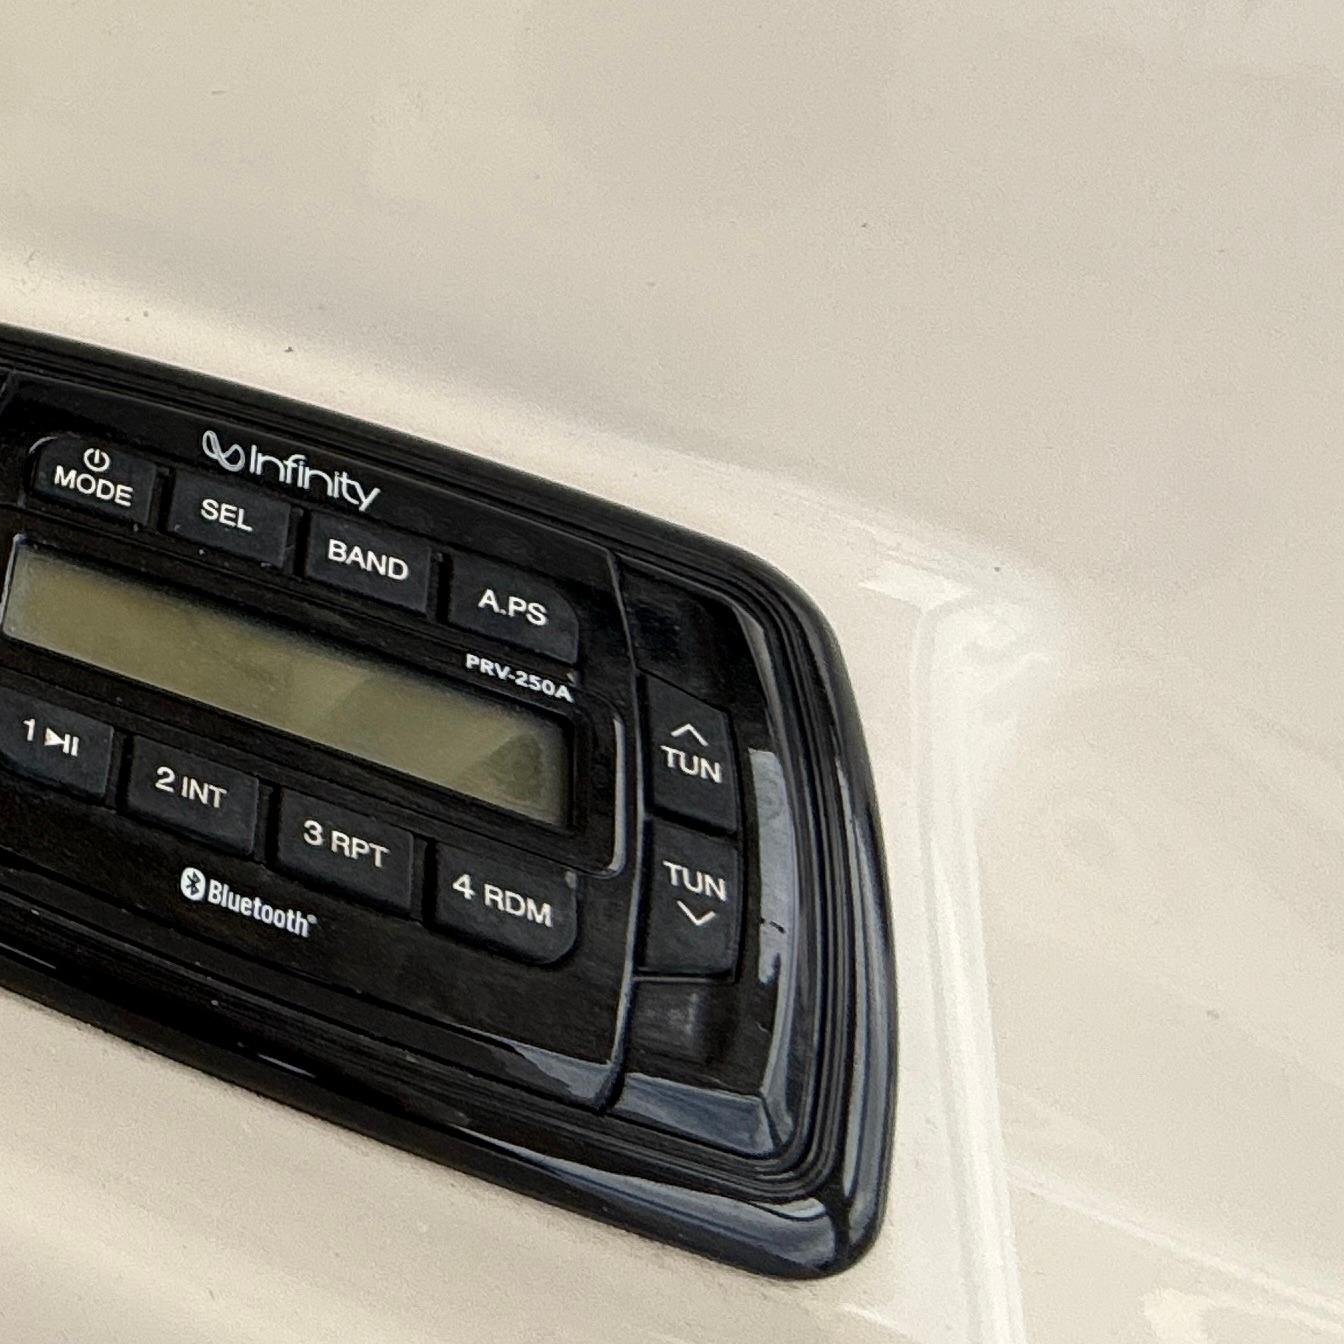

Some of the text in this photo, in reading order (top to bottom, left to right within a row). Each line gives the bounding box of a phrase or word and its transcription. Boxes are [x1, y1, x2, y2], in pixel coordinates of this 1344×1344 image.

[53, 465, 134, 507] MODE
[200, 499, 254, 533] SEL
[327, 538, 409, 582] BAND
[478, 588, 548, 626] A.PS
[465, 653, 575, 703] PRV-250A
[22, 718, 36, 742] 1
[660, 745, 722, 784] TUN
[155, 767, 228, 809] 2 INT
[303, 820, 390, 869] 3 RPT
[452, 874, 554, 928] 4 RDM
[663, 861, 727, 902] TUN
